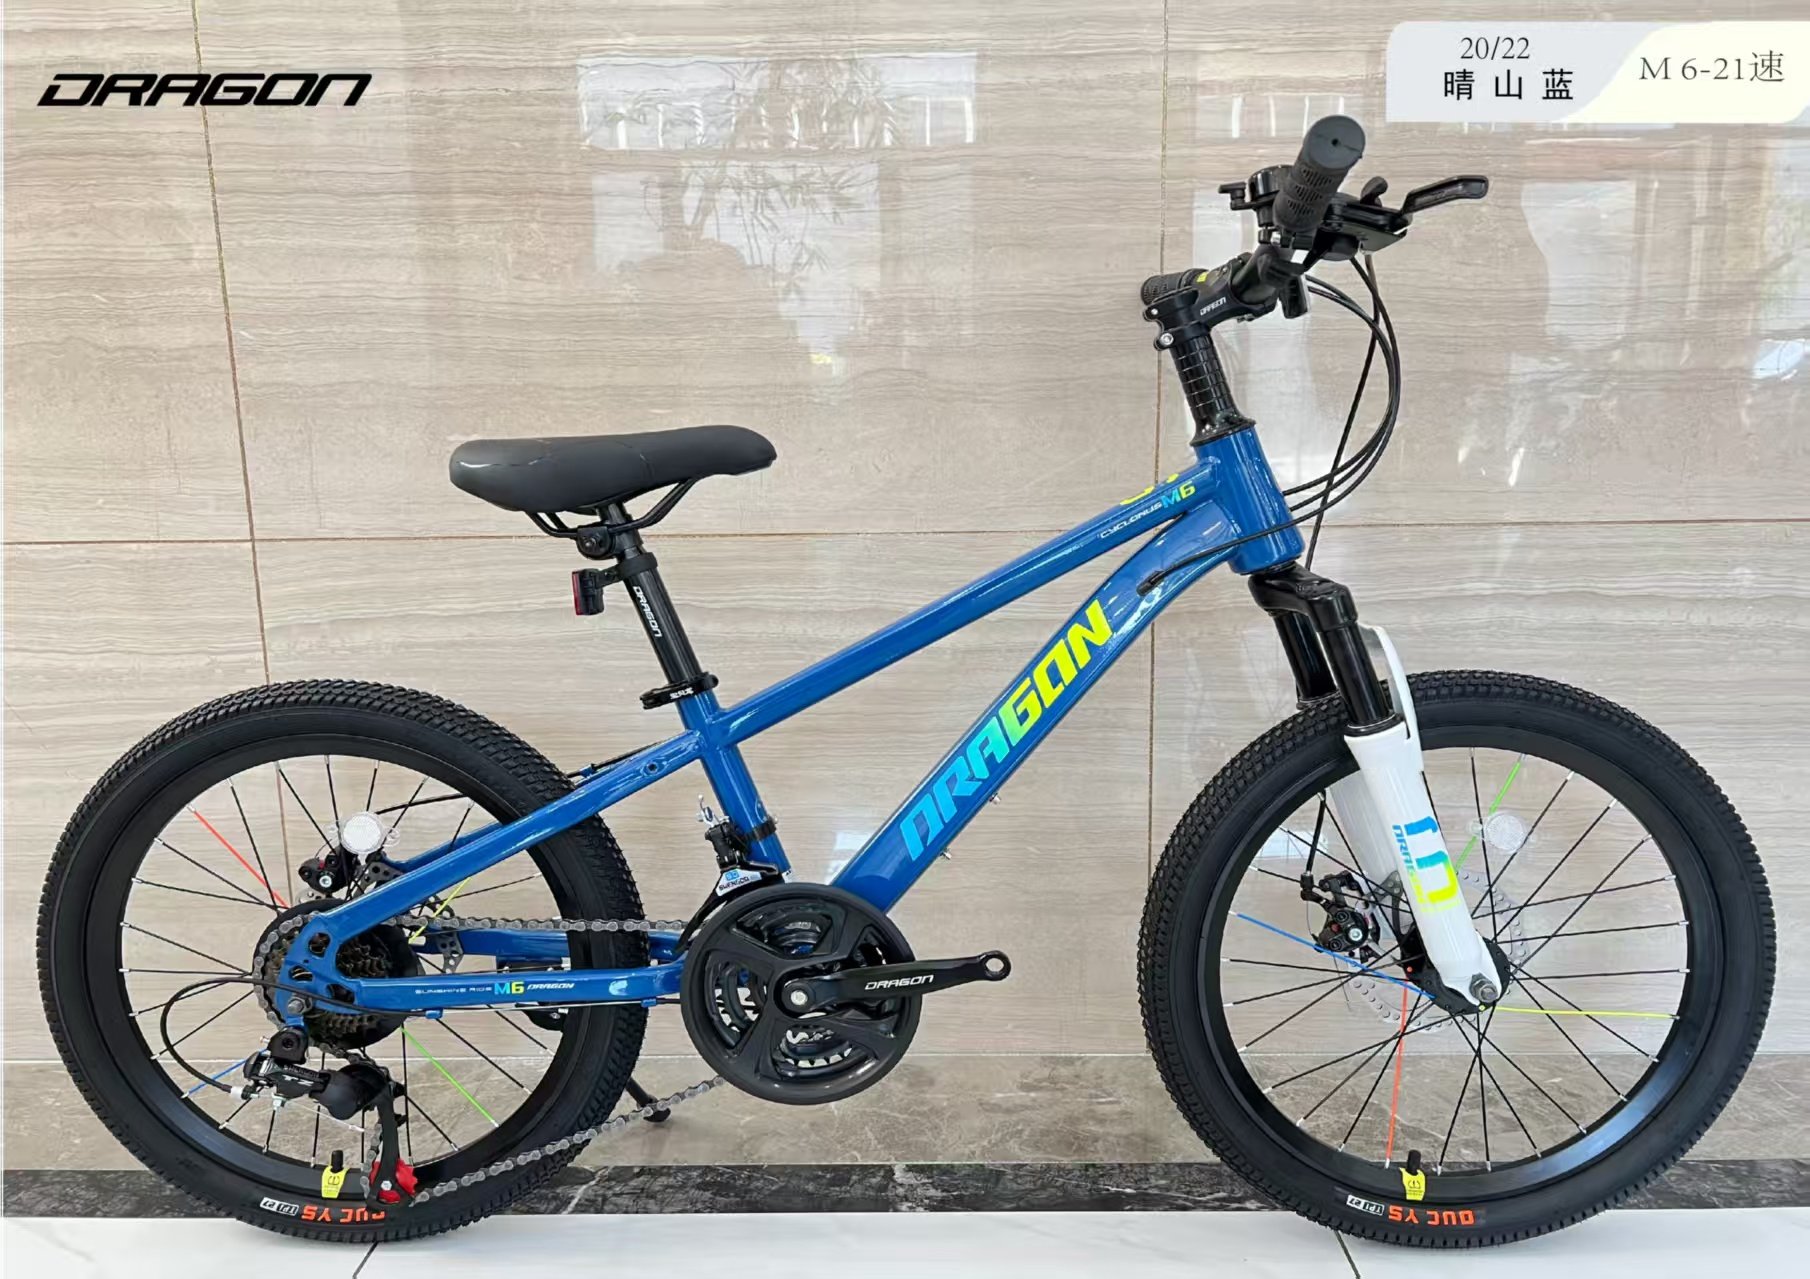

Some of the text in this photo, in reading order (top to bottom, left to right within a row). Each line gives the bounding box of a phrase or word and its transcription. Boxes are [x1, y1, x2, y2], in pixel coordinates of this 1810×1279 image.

[1199, 296, 1227, 316] DRAGON
[1160, 480, 1196, 508] M6
[633, 585, 664, 638] DRAGON
[899, 598, 1115, 862] DRAGON
[493, 981, 525, 996] M6
[526, 982, 575, 991] DRAGON
[864, 973, 935, 991] DRAGON
[1364, 1202, 1381, 1213] TPI
[1388, 1205, 1420, 1224] YS
